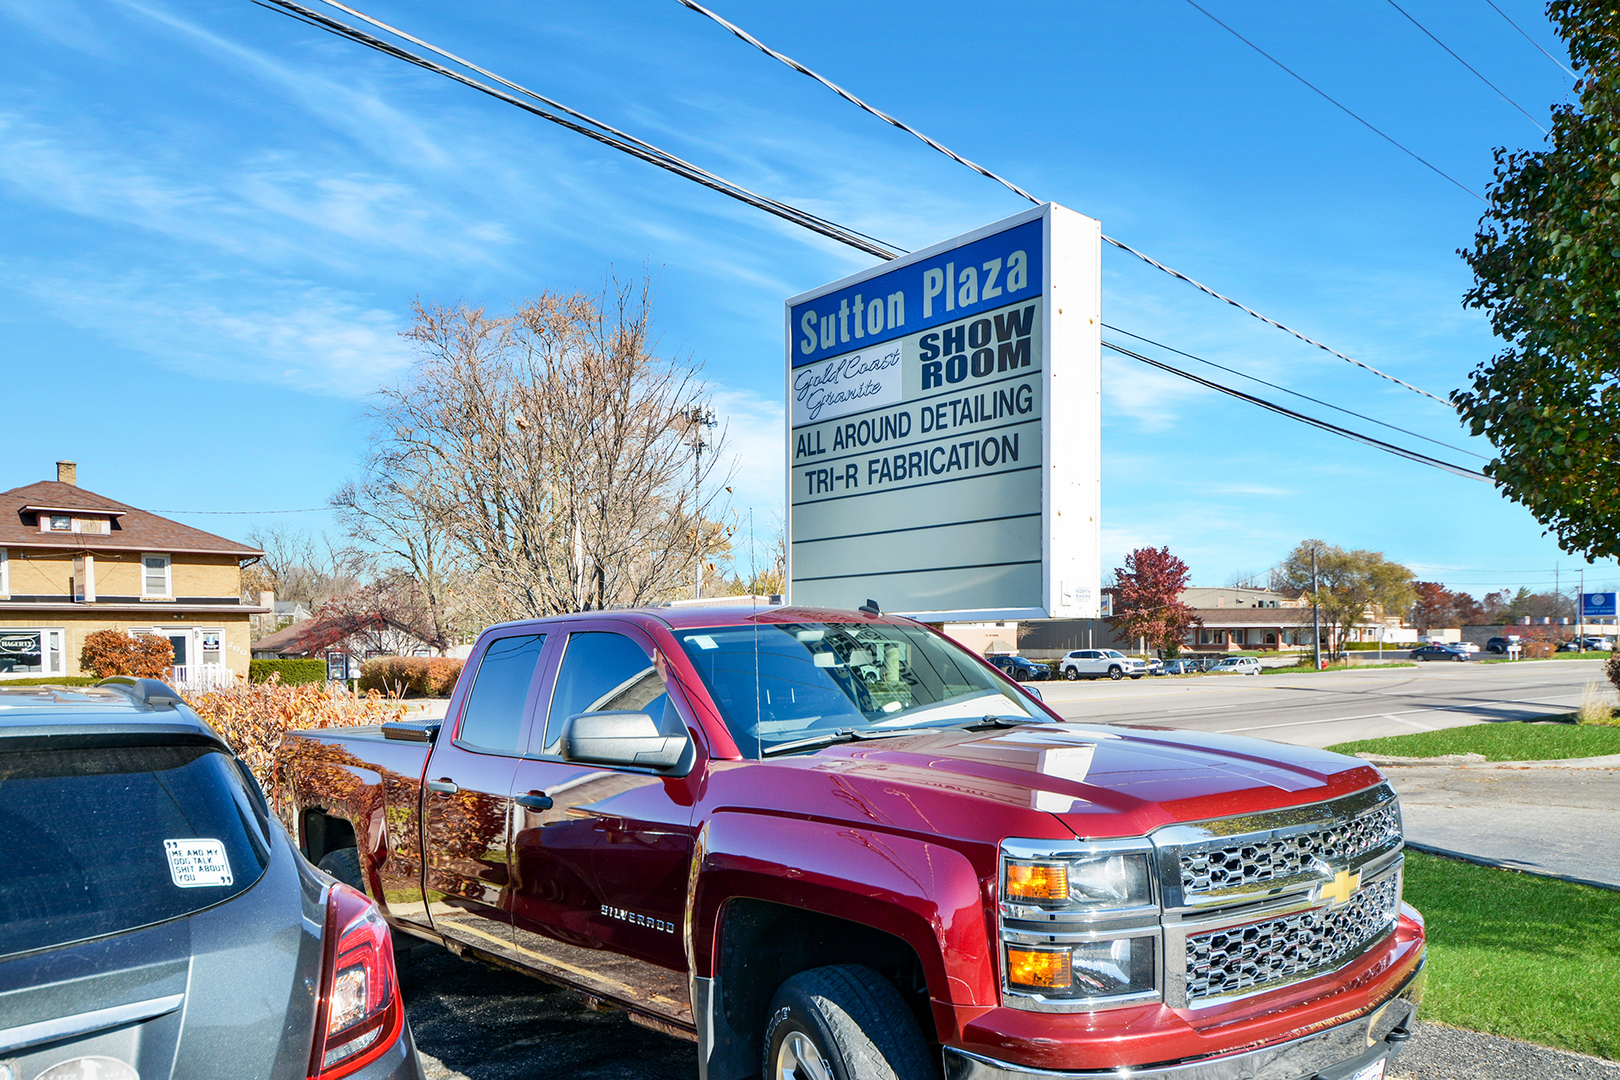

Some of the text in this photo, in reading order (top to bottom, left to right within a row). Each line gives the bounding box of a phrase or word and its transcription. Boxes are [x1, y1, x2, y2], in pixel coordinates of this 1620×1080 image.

[800, 249, 1028, 355] Sutton Plaza
[919, 304, 1036, 362] SHOW
[793, 348, 900, 401] Gold Coast
[921, 336, 1032, 391] ROOM
[796, 383, 1033, 458] ALL AROUND DETAILING
[806, 379, 882, 420] Granite
[805, 433, 1019, 495] TRI-R FABRICATION
[172, 849, 183, 857] ME
[173, 857, 191, 865] DOG
[175, 864, 226, 873] SHIT ABOUT
[600, 904, 675, 934] SILVERADO
